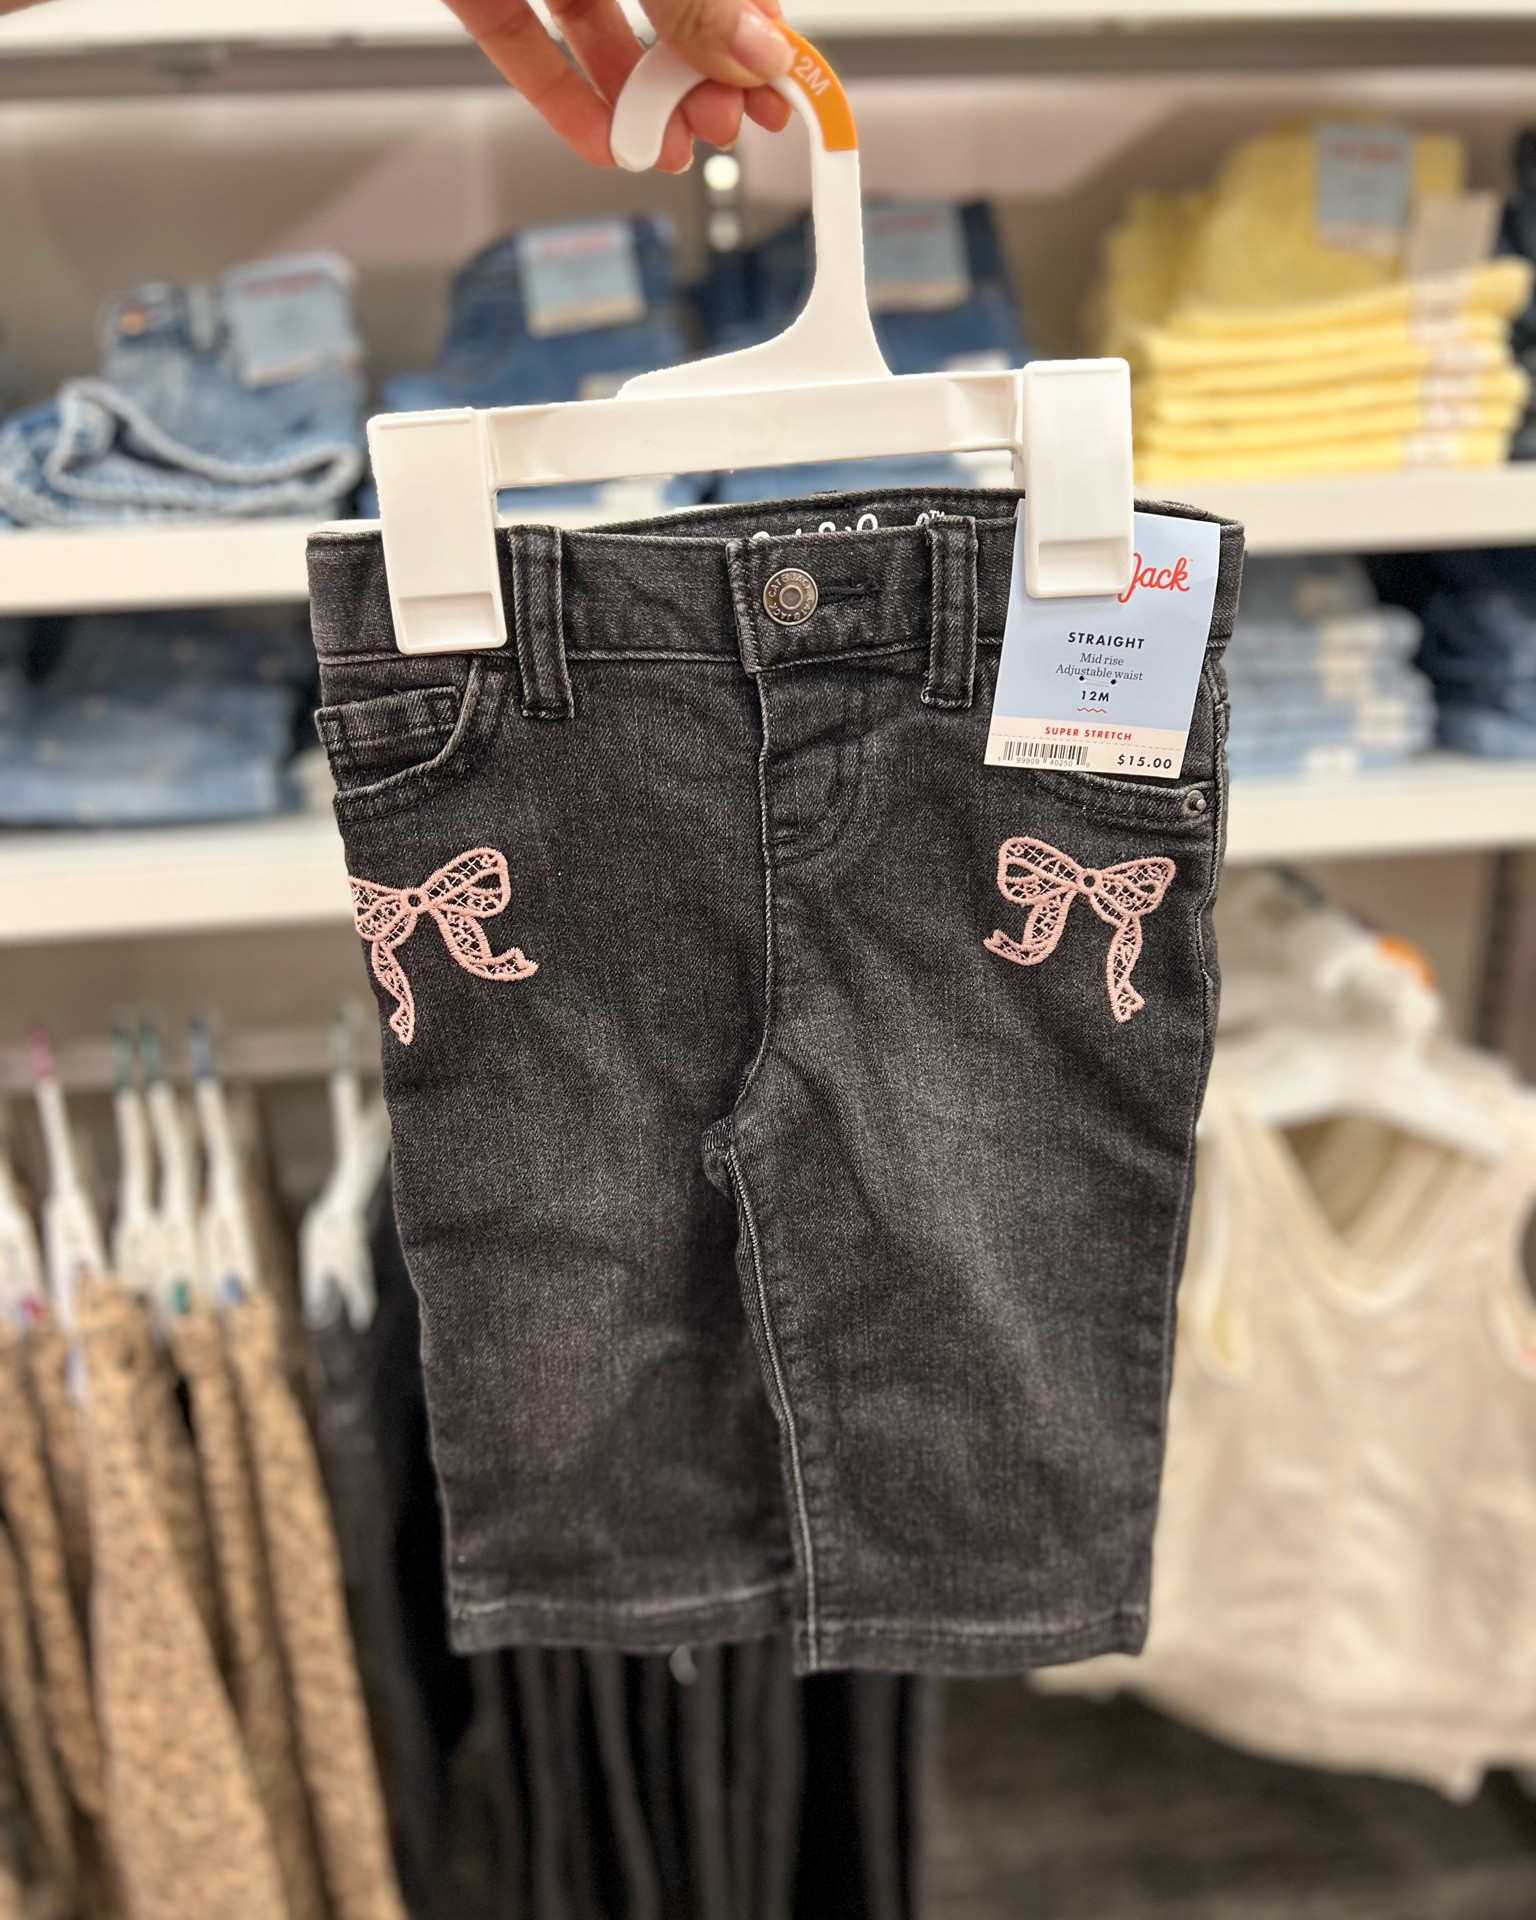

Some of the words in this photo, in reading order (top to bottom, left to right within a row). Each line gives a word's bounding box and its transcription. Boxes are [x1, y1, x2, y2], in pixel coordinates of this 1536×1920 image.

[793, 46, 831, 97] 2M
[1117, 552, 1191, 603] Jack
[1067, 631, 1145, 650] STRAIGHT
[1079, 652, 1103, 665] Mid
[1103, 655, 1125, 667] rise
[1055, 663, 1113, 679] Adjustable
[1114, 670, 1144, 681] waist
[1080, 690, 1110, 703] 12M
[1045, 726, 1080, 738] SUPER
[1084, 729, 1133, 742] STRETCH
[1117, 754, 1173, 771] $15.00
